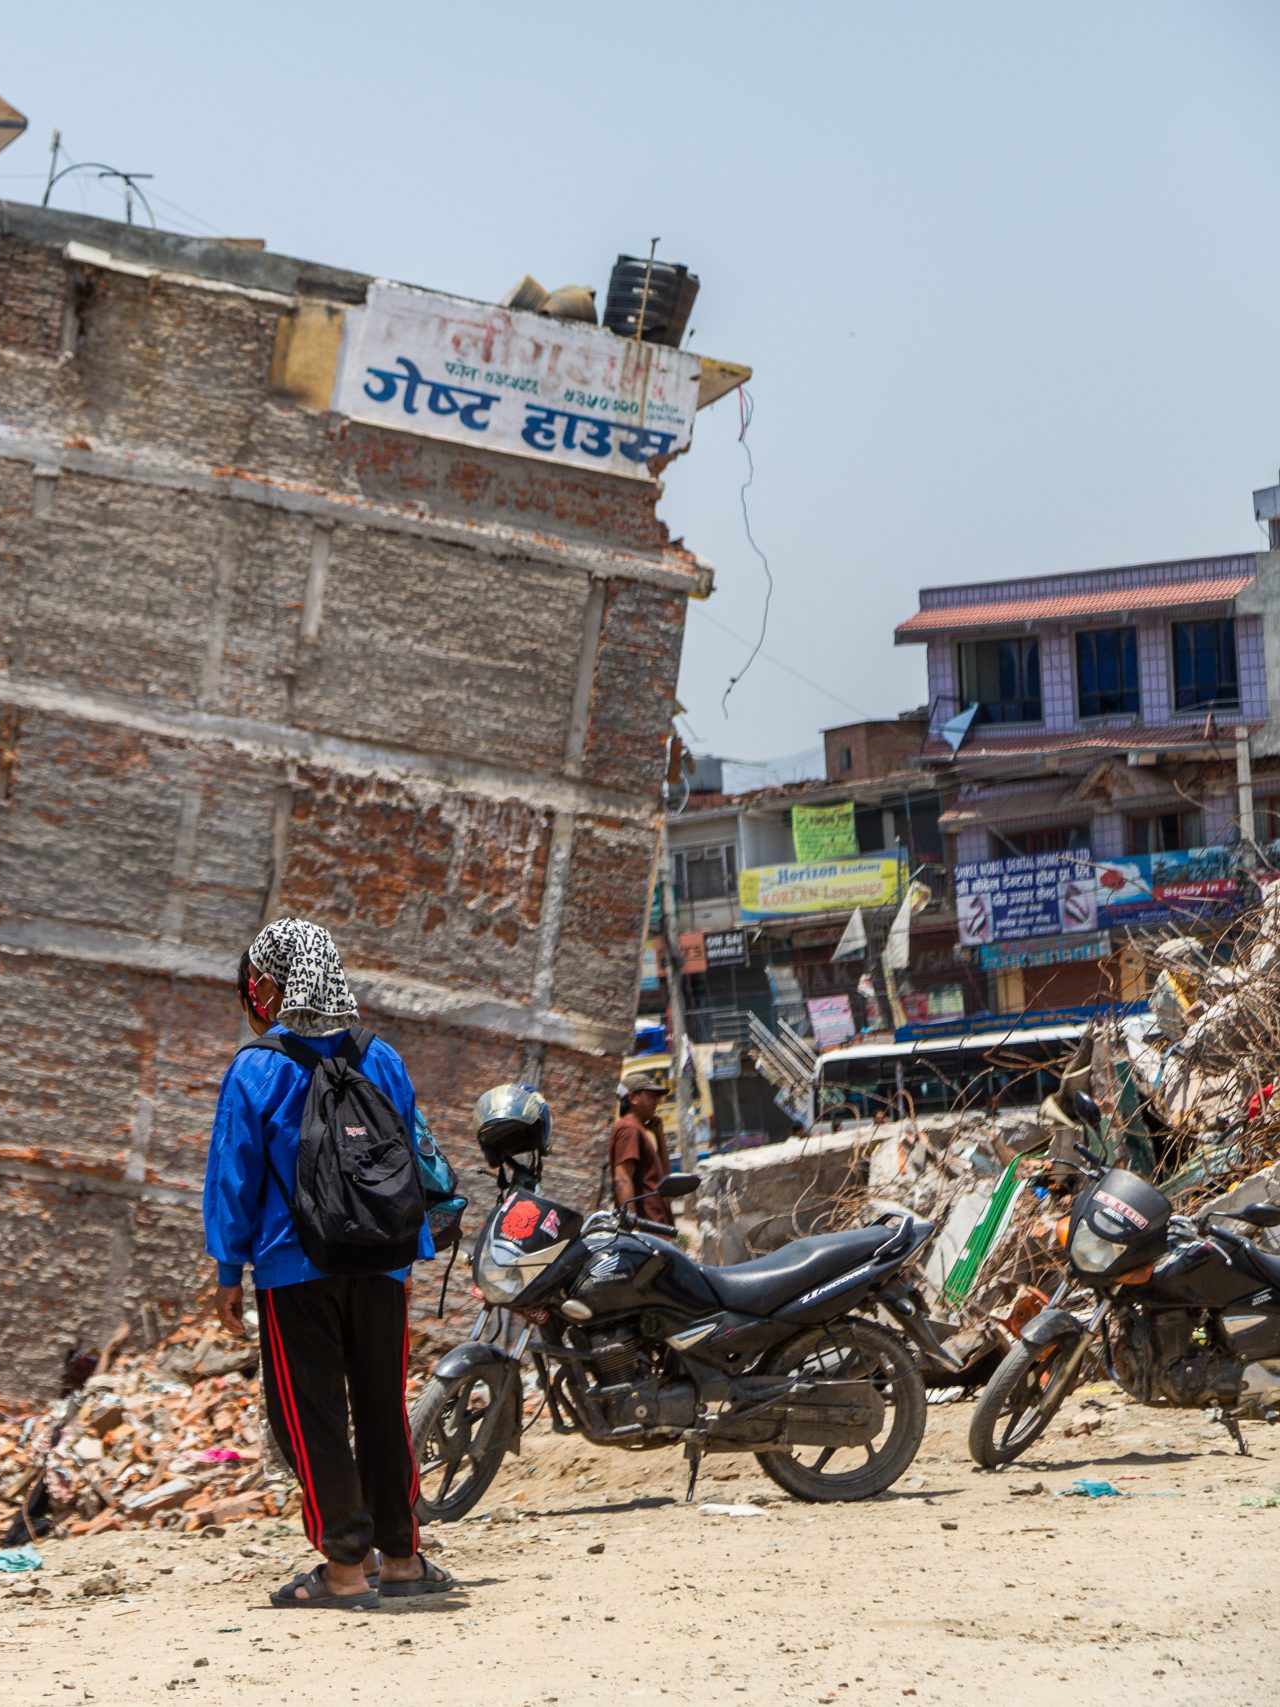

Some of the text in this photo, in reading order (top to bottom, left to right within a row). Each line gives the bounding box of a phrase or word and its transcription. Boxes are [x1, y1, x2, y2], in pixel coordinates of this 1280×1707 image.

[520, 401, 678, 464] हाउस
[777, 863, 881, 885] Horizon Academy
[761, 880, 882, 908] KOREAN Language
[1163, 884, 1203, 899] Study
[1206, 880, 1219, 894] in
[590, 1272, 628, 1284] HONDA
[799, 1264, 871, 1305] UNICORN
